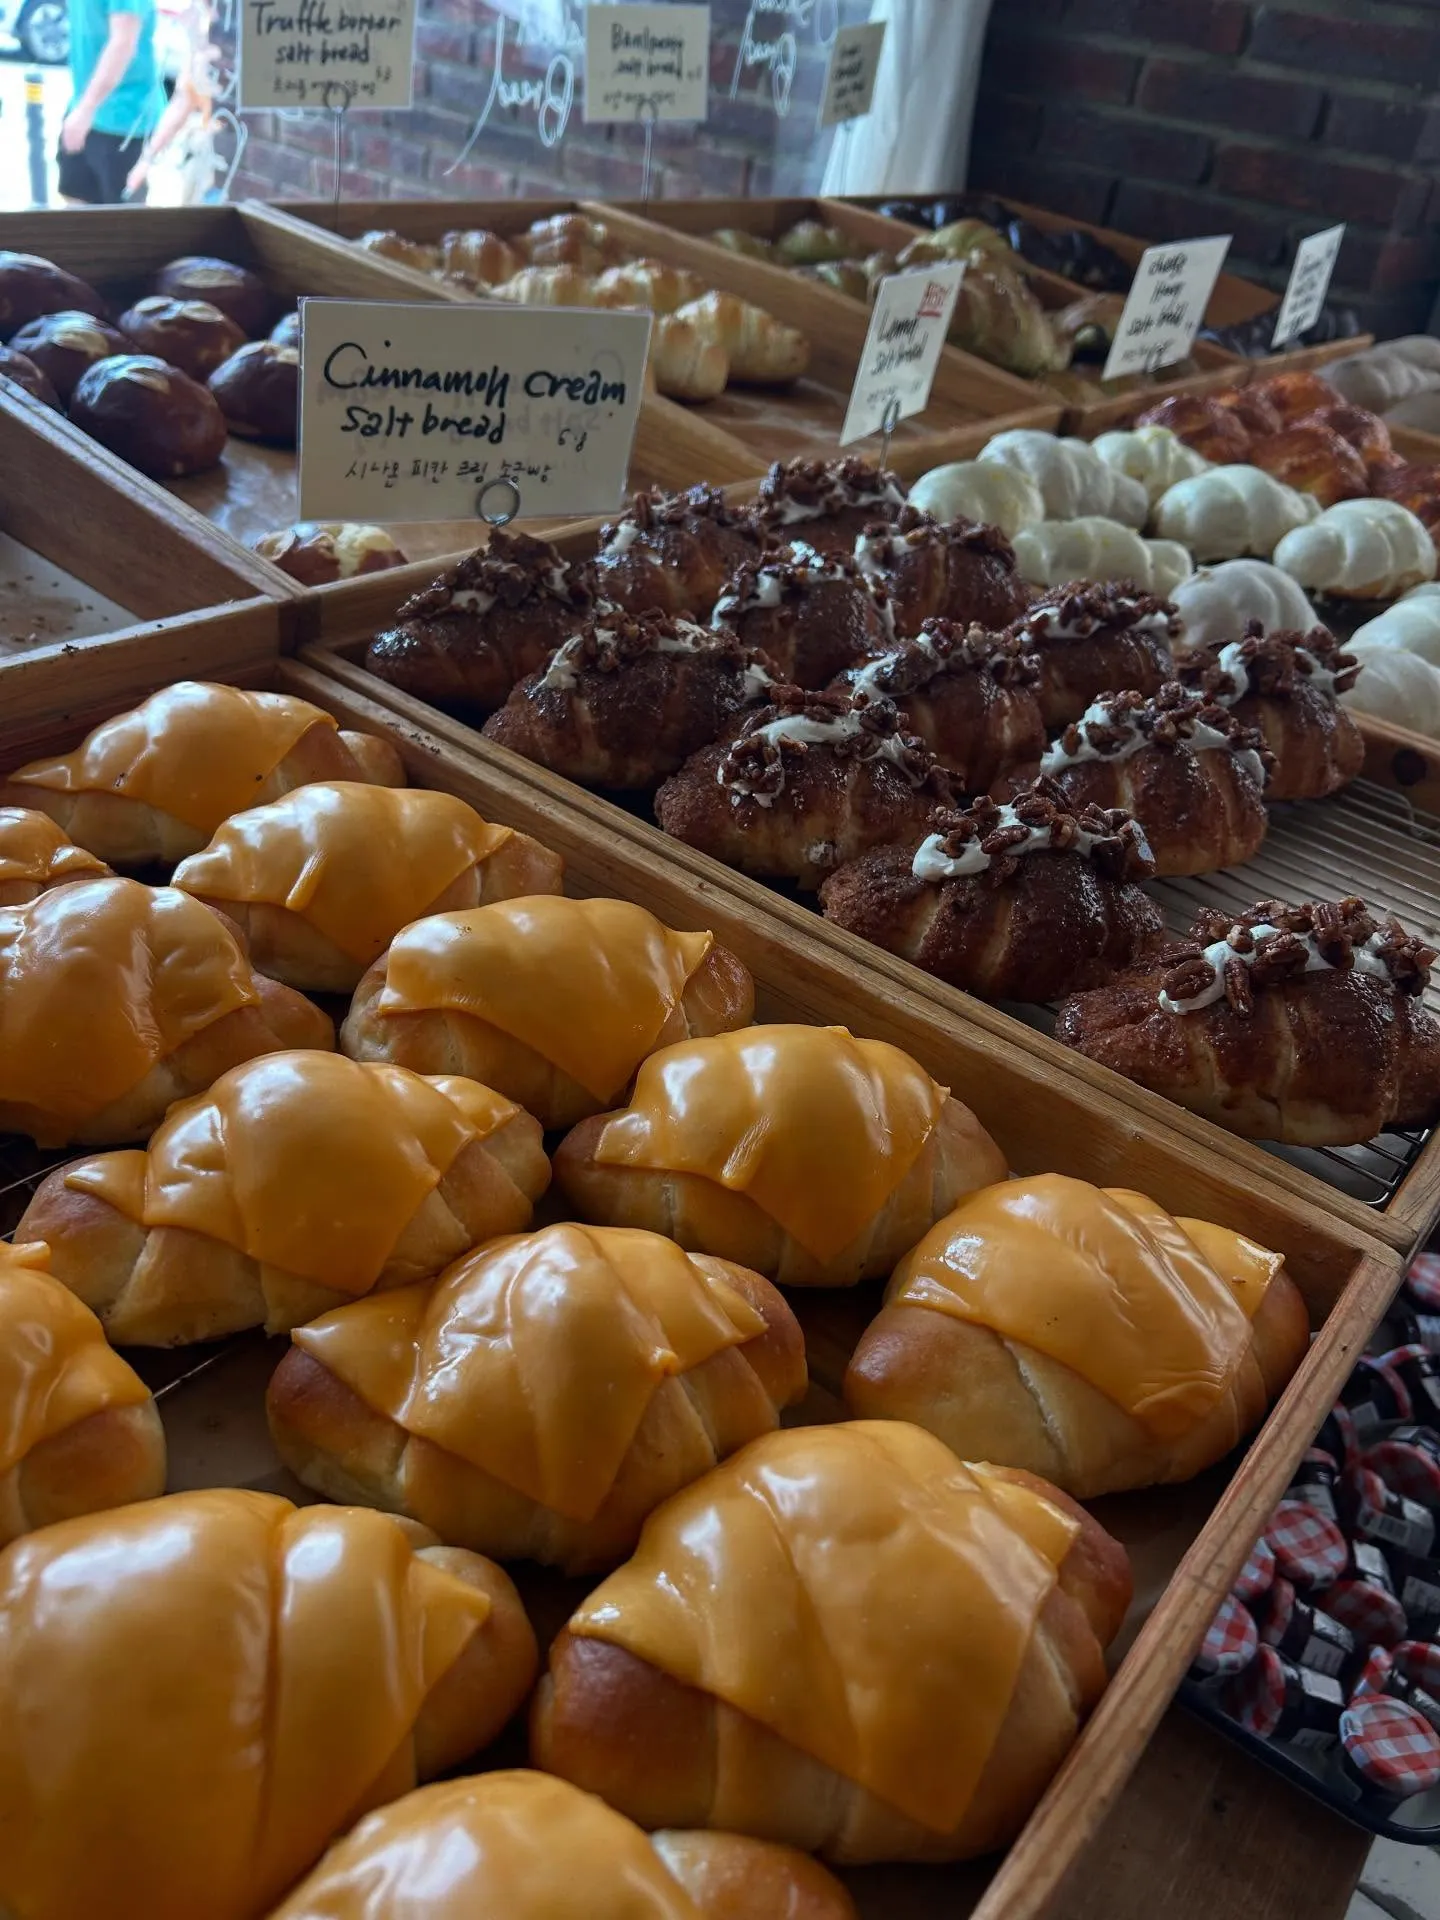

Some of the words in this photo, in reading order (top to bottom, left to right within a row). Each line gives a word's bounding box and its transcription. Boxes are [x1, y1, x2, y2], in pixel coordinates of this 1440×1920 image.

[320, 33, 370, 65] bread
[323, 340, 509, 408] Cinnamon
[422, 403, 506, 444] bread
[345, 460, 400, 488] 시나몬
[411, 459, 448, 483] 피칸
[456, 460, 489, 483] 크림
[500, 458, 552, 483] 소금빵
